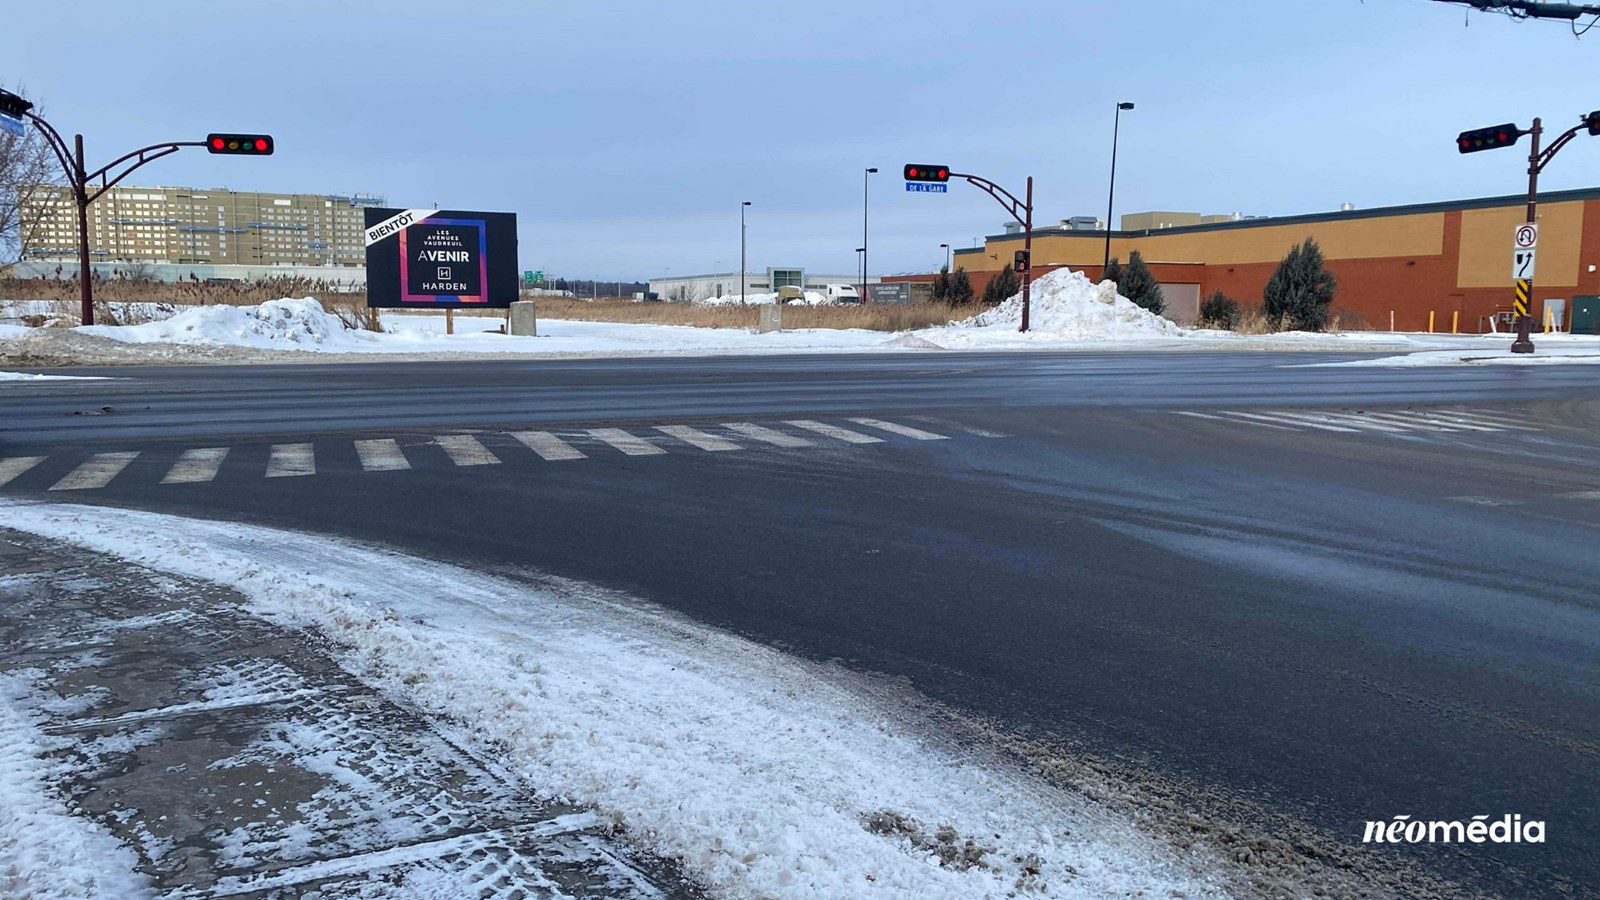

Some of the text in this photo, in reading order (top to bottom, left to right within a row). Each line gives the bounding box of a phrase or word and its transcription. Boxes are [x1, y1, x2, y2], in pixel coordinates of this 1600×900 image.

[369, 212, 414, 241] BIENTÔT
[417, 250, 470, 262] AVENIR
[422, 282, 467, 291] HARDEN
